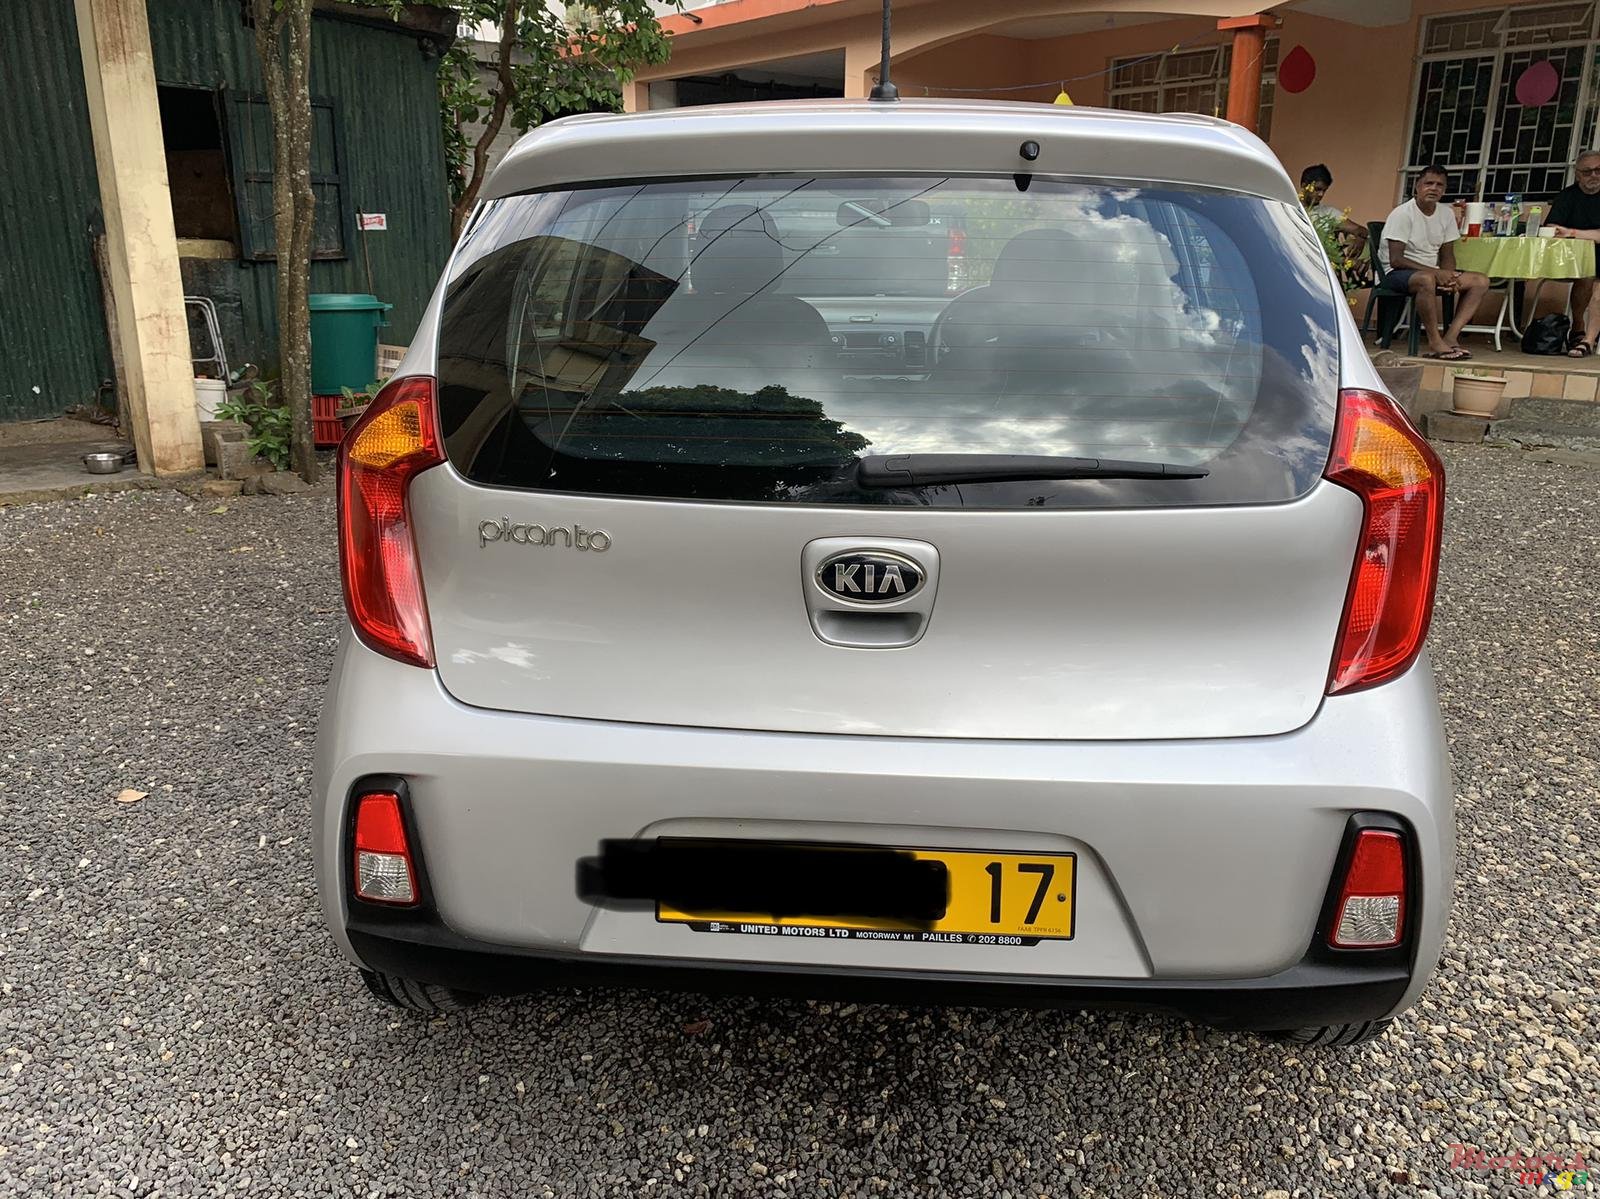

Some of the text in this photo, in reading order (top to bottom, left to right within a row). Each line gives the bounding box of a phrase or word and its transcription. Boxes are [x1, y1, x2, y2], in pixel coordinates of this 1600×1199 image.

[478, 514, 612, 552] picanto
[835, 563, 906, 593] KIA
[985, 861, 1055, 925] 17
[740, 924, 779, 935] UNITED
[781, 926, 826, 937] MOTORS
[829, 928, 849, 938] LTD
[856, 931, 900, 940] MOTORWAY
[903, 933, 915, 941] M1
[922, 932, 963, 943] PAILLES
[978, 935, 999, 944] 202
[998, 935, 1022, 945] 8800
